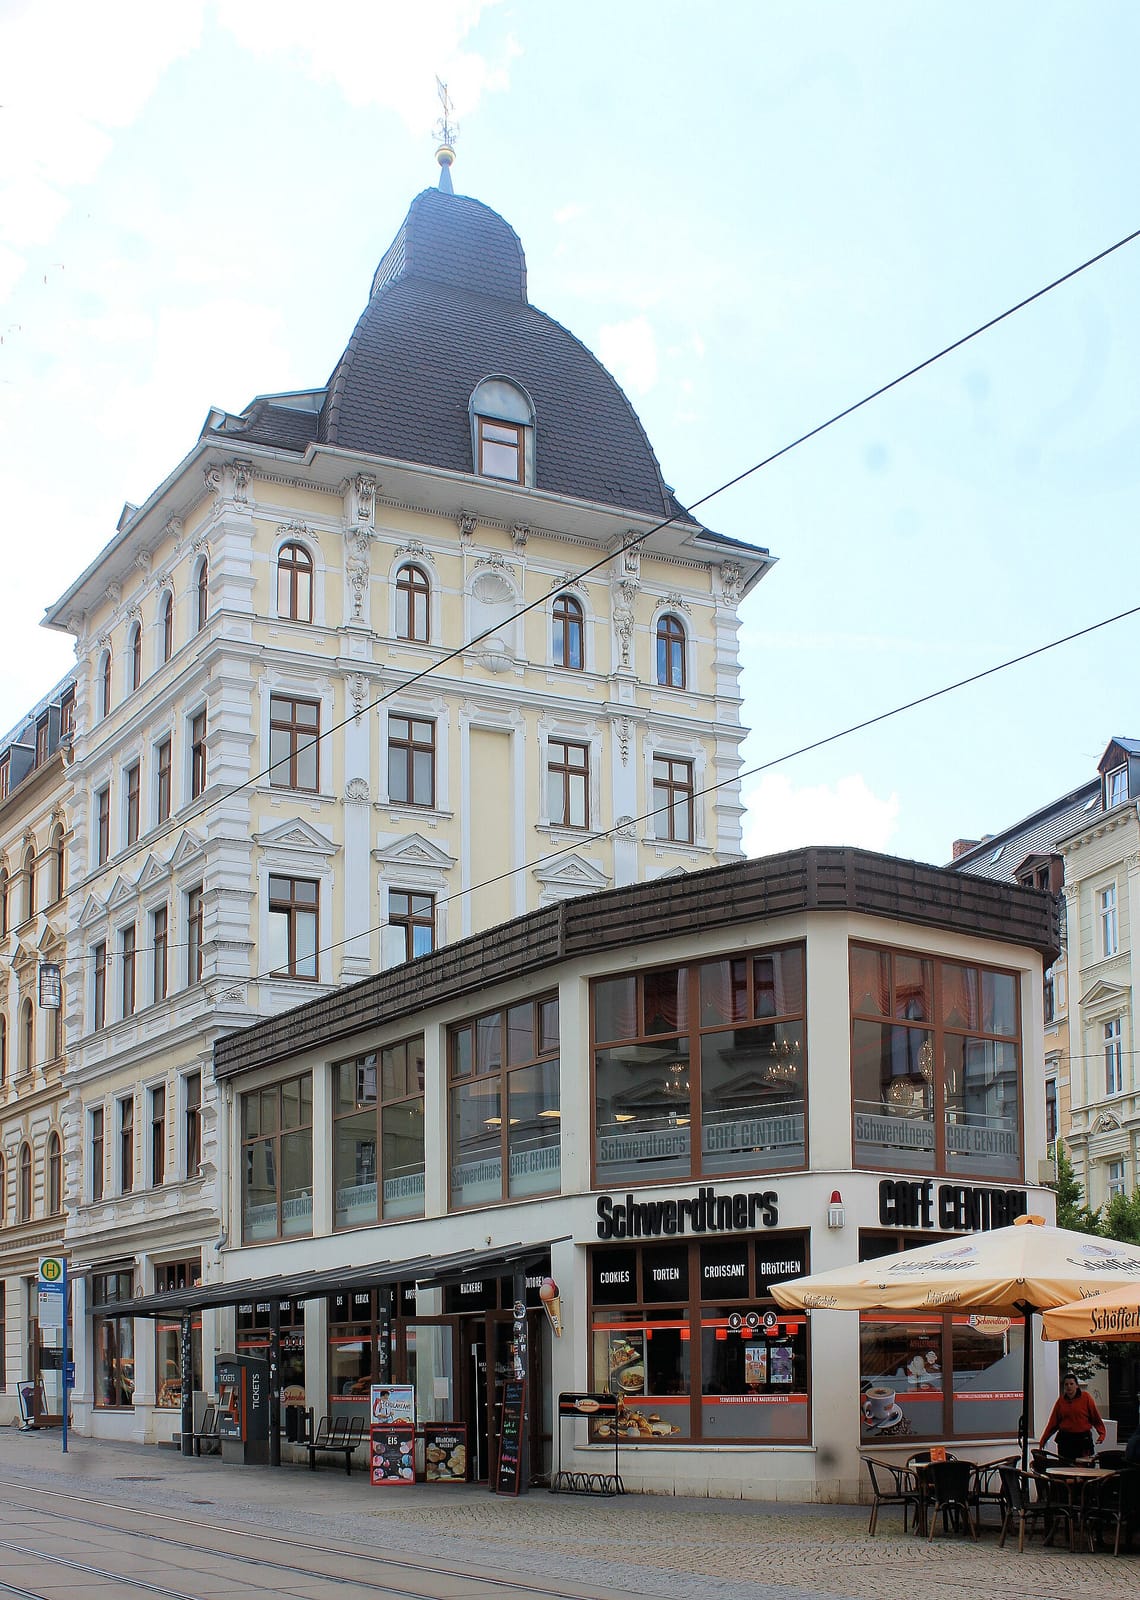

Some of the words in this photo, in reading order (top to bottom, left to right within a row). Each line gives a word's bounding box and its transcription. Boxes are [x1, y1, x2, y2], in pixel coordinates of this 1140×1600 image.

[601, 1134, 686, 1160] Schwerdtners
[707, 1126, 736, 1150] CAFE
[742, 1118, 799, 1146] CENTRAL
[856, 1117, 934, 1146] Schwerdtners
[947, 1126, 972, 1150] CAFE
[974, 1129, 1018, 1154] CENTRAL
[597, 1187, 778, 1239] Schwerdtners
[879, 1179, 934, 1227] CAFÉ
[600, 1271, 630, 1284] COOKIES
[652, 1267, 679, 1281] TORTEN
[704, 1264, 745, 1278] CROISSANT
[252, 1373, 260, 1410] TICKETS
[387, 1436, 398, 1445] EIS
